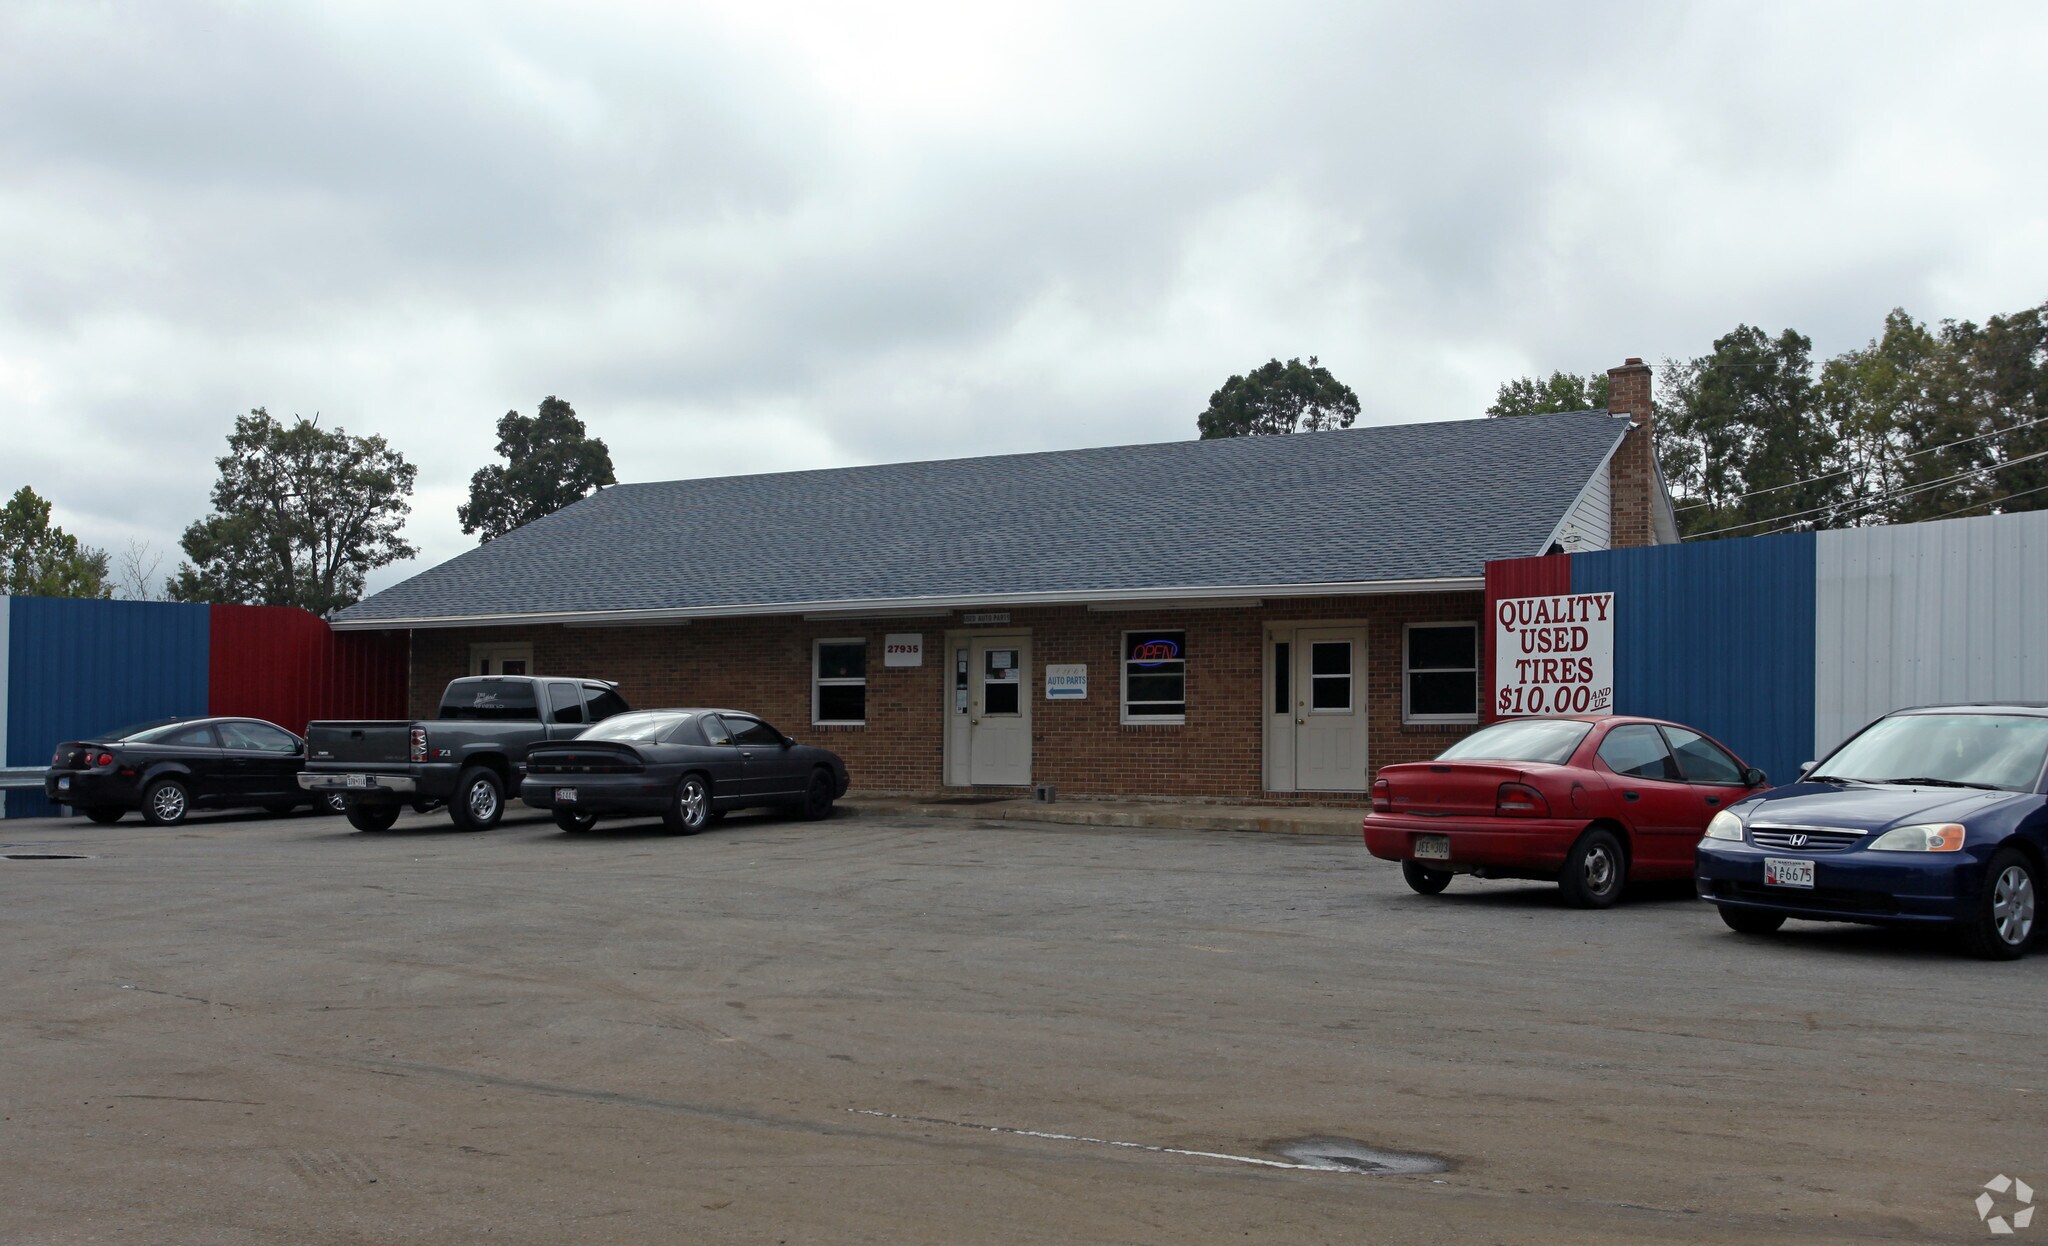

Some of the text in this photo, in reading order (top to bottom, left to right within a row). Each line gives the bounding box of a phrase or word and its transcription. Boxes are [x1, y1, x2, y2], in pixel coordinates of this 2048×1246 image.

[993, 613, 1010, 621] PARTS
[1499, 595, 1611, 632] QUALITY
[1520, 626, 1588, 654] USED
[888, 645, 919, 653] 27935
[1134, 644, 1174, 660] OPEN
[1515, 657, 1593, 684] TIRES
[1048, 675, 1086, 685] AUTO PARTS
[1498, 684, 1590, 713] $10.00
[1591, 687, 1611, 700] AND
[1594, 697, 1607, 707] UP
[1417, 841, 1431, 853] JEE
